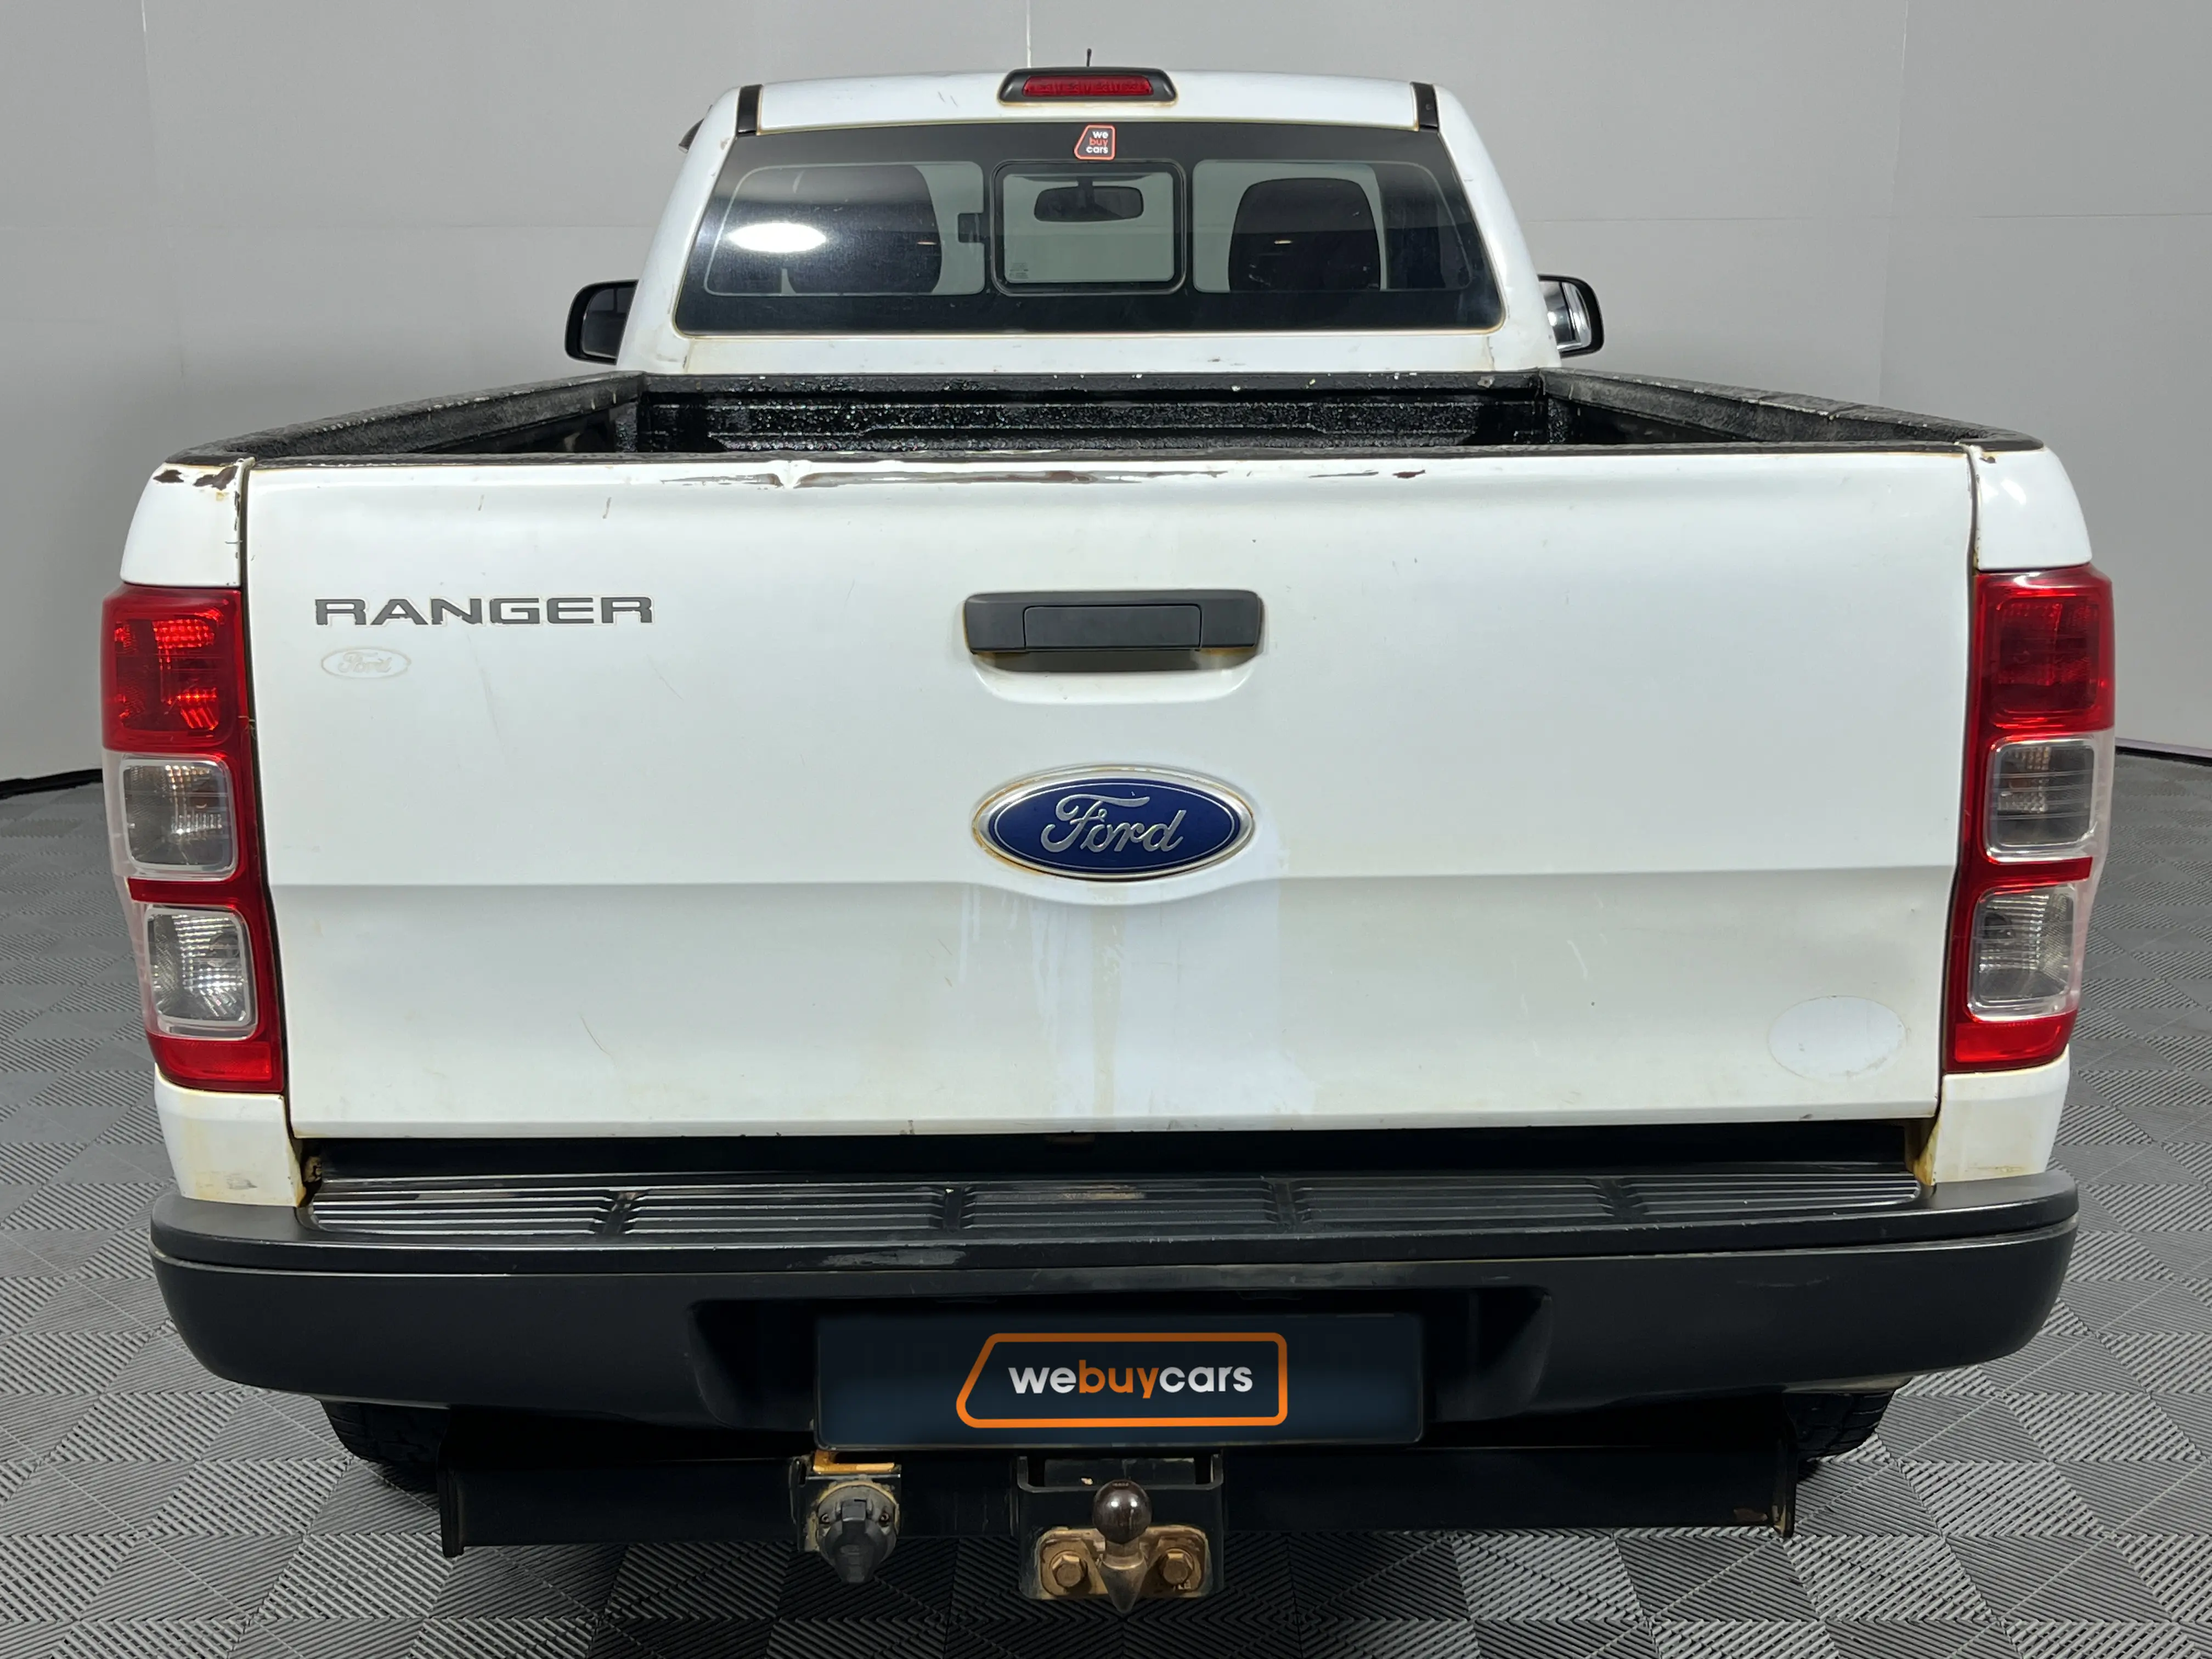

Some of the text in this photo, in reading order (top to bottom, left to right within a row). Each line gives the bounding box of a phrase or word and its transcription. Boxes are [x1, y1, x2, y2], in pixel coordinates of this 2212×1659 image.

[1089, 137, 1108, 147] buy
[315, 597, 653, 625] RANGER
[1041, 793, 1187, 852] Ford
